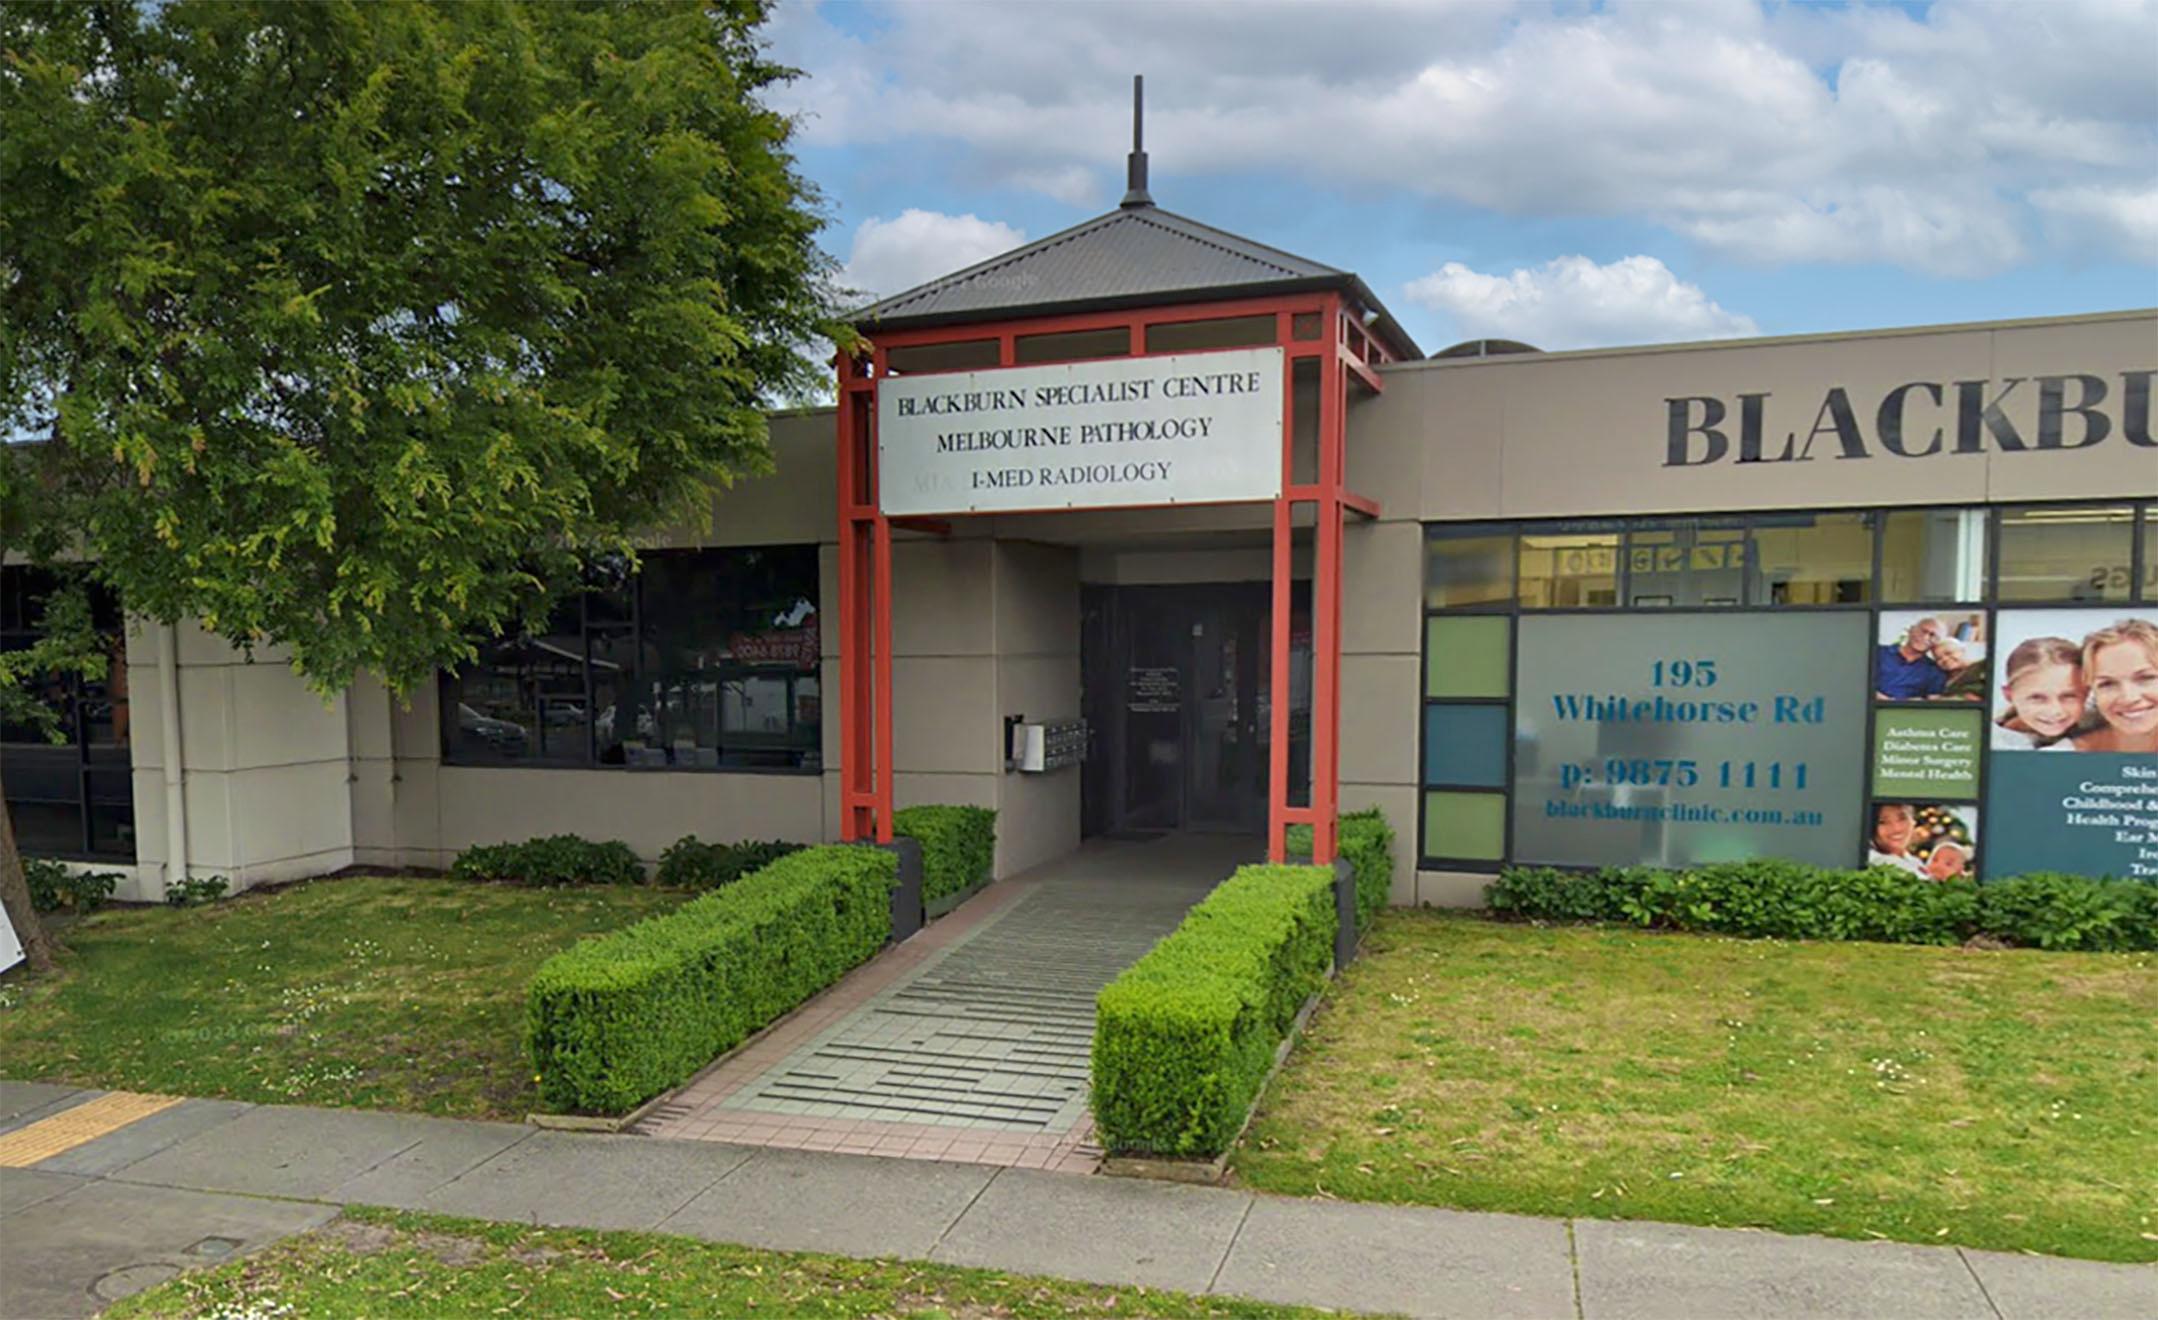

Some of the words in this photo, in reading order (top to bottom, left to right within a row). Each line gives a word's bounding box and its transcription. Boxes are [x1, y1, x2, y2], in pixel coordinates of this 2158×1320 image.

[898, 388, 1027, 417] BLACKBURN
[1035, 379, 1155, 409] SPECIALIST
[1162, 371, 1261, 398] CENTRE
[936, 425, 1072, 454] MELBOURNE
[1080, 416, 1214, 445] PATHOLOGY
[971, 467, 1034, 490] I-MED
[1039, 461, 1173, 487] RADIOLOGY
[1651, 660, 1717, 688] 195
[1552, 694, 1758, 724] Whitehorse
[1773, 696, 1824, 724] Rd
[1886, 728, 1936, 738] Asthma
[1939, 727, 1969, 738] Care
[1883, 741, 1938, 752] Diabetes
[1941, 741, 1972, 752] Care
[1881, 754, 1920, 765] Minor
[1923, 755, 1971, 768] Surgery
[1560, 763, 1592, 790] p:
[1606, 759, 1698, 787] 9875
[1717, 761, 1808, 790] 1111
[1880, 768, 1925, 779] Mental
[1928, 769, 1973, 780] Health
[2121, 766, 2157, 778] Skin
[2062, 797, 2143, 810] Childhood
[1545, 799, 1824, 826] blackburnclinic.com.au
[2066, 813, 2120, 826] Health
[2115, 831, 2144, 843] Ear
